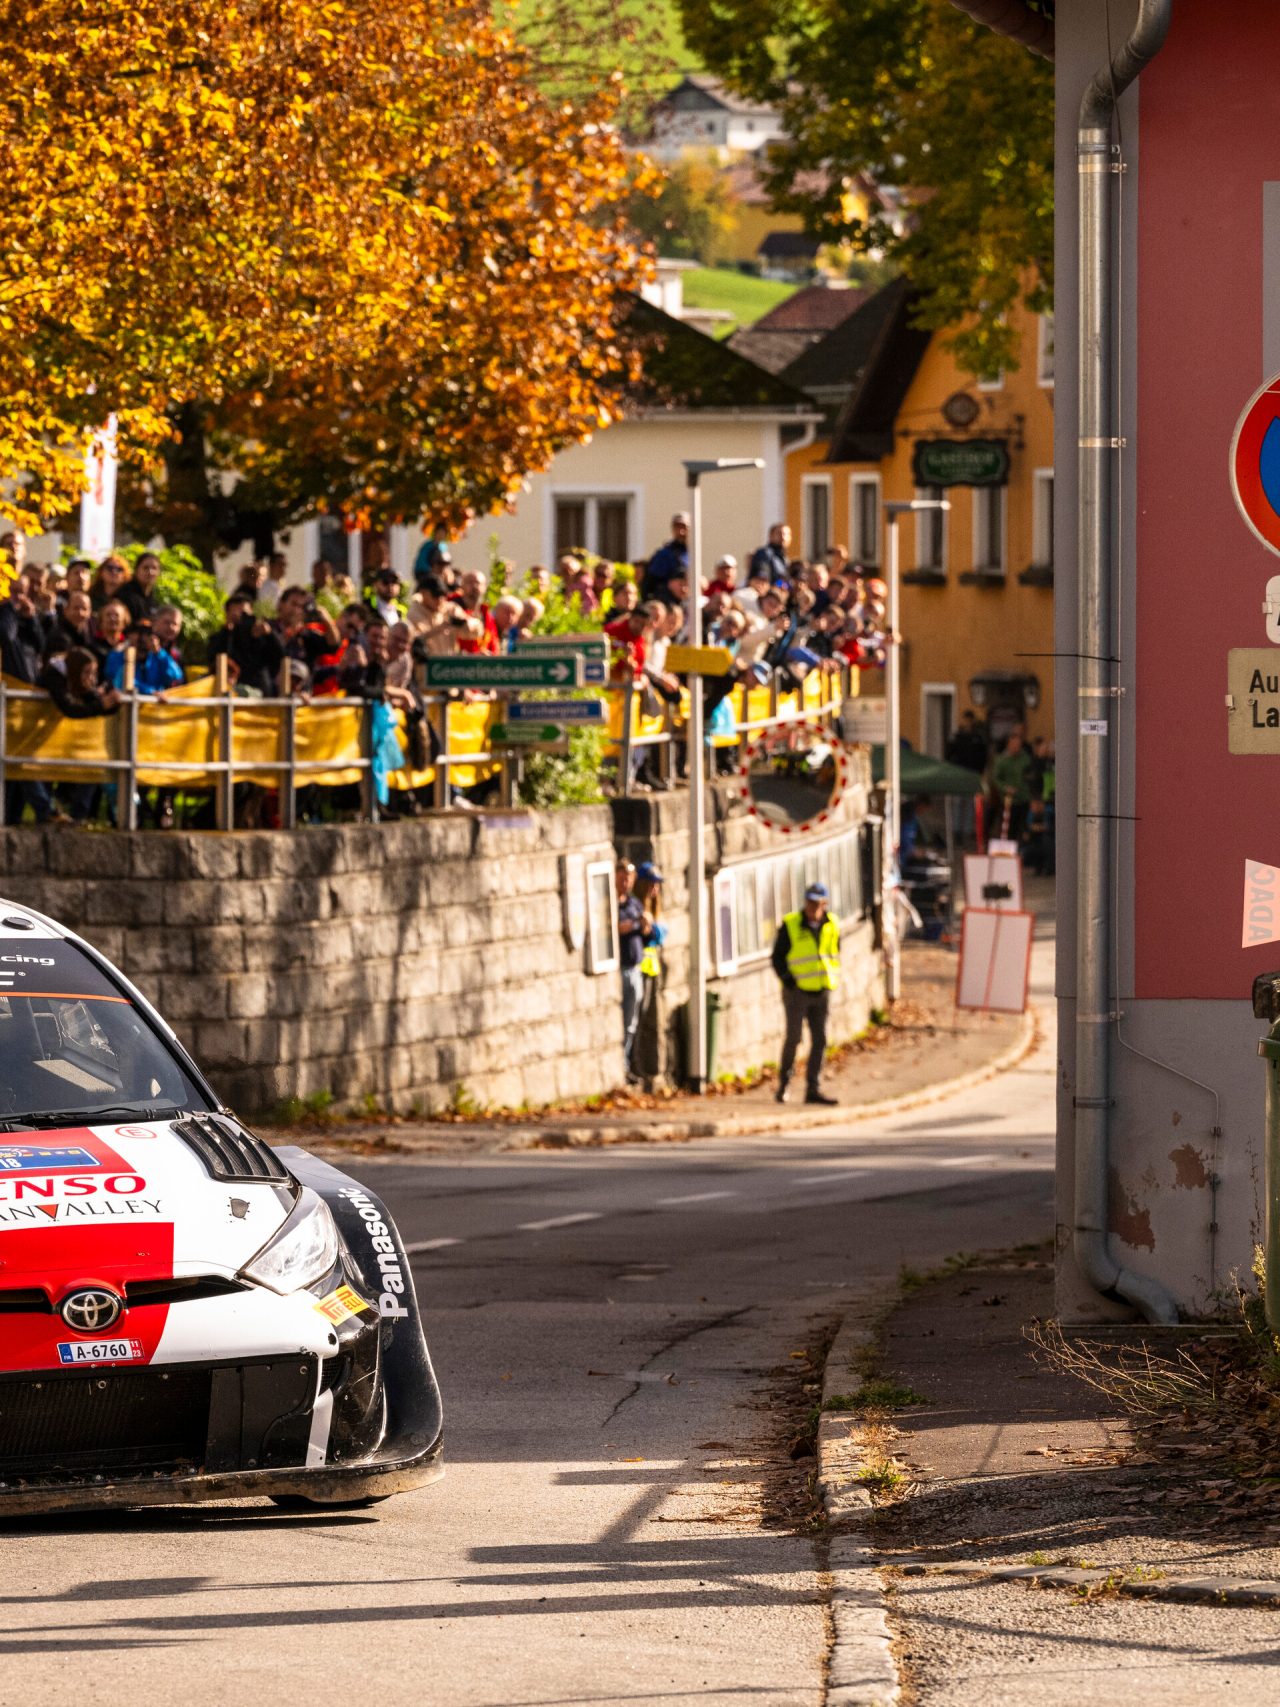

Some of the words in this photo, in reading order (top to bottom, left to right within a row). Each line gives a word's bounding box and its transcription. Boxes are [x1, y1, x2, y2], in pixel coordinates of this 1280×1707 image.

[431, 662, 544, 681] Gemeindeamt
[338, 1187, 409, 1318] Panasonic
[77, 1343, 127, 1359] A-6760
[131, 1340, 139, 1348] 11
